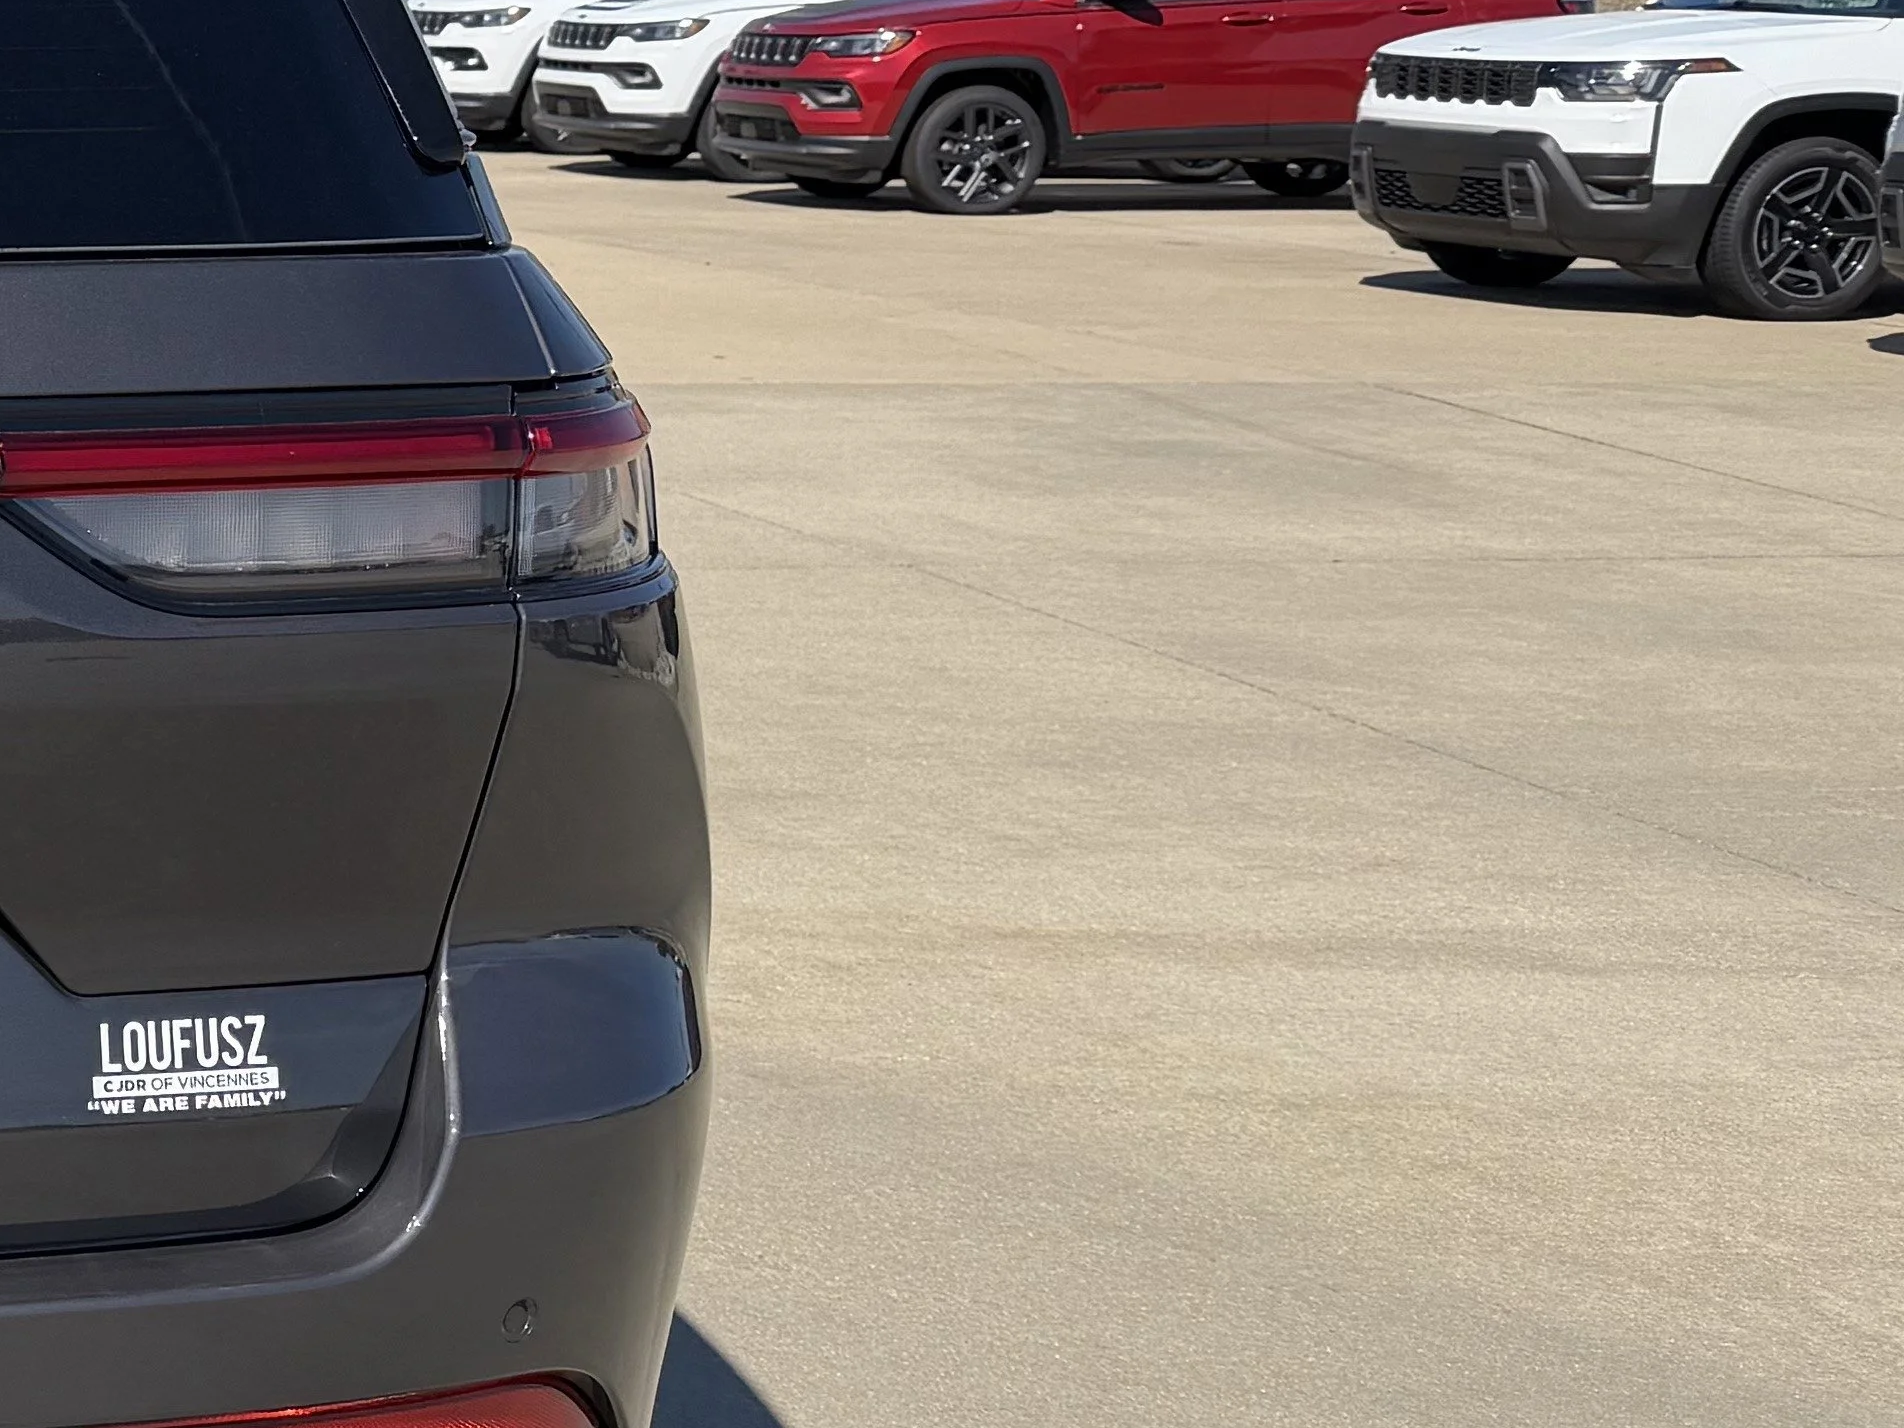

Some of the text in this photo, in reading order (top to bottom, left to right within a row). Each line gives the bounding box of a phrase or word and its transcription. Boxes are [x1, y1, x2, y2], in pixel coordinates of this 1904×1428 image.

[103, 1071, 270, 1093] CJDR OF VINCENNES
[142, 1096, 189, 1113] ARE
